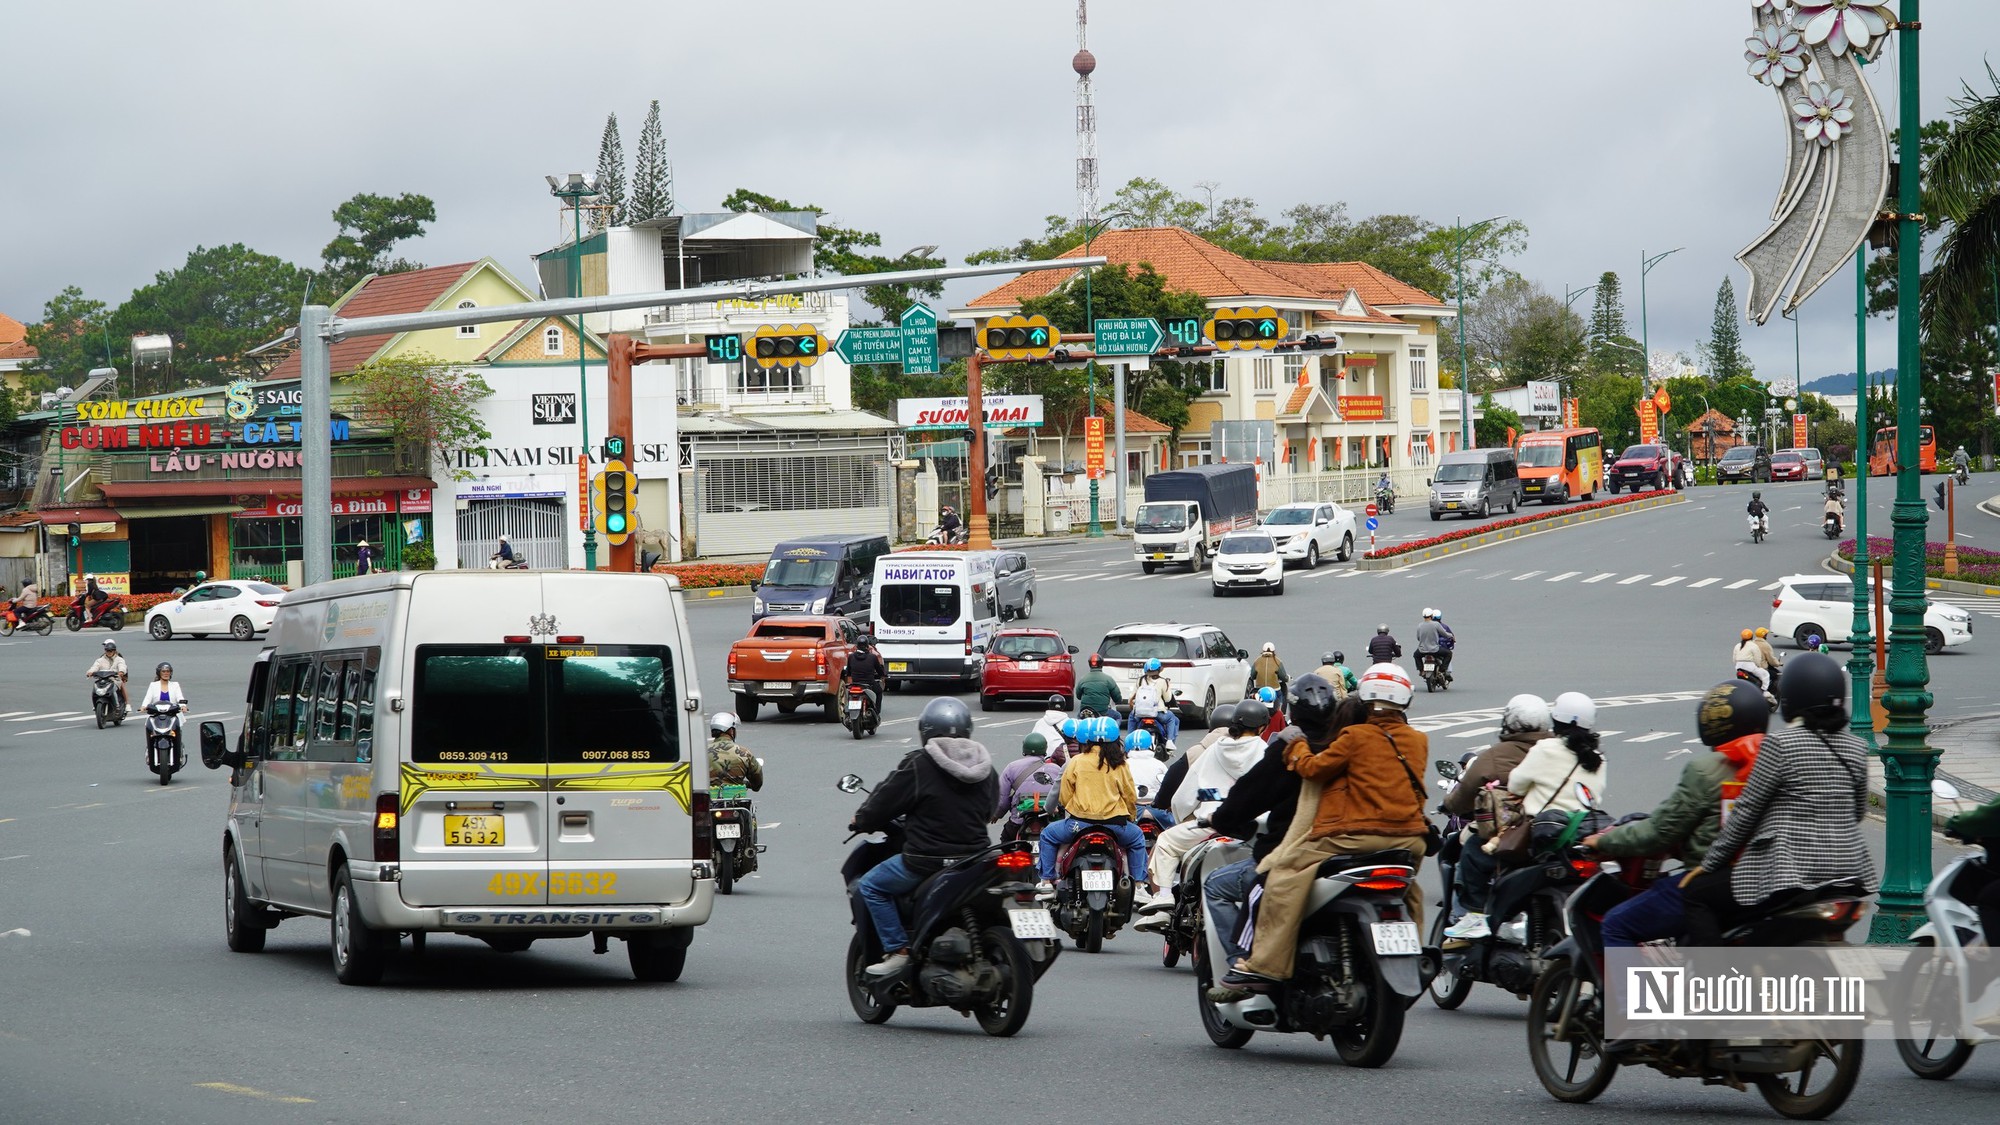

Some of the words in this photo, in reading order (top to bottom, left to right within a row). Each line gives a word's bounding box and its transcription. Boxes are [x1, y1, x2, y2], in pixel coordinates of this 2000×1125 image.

[1098, 322, 1113, 330] KHU
[1130, 319, 1148, 329] BÌNH
[850, 330, 862, 339] THÁC
[1102, 331, 1118, 341] CHỢ
[1119, 329, 1130, 340] ĐÀ
[1131, 331, 1146, 342] LẠT
[1169, 320, 1198, 344] 40
[886, 340, 900, 350] LÂM
[911, 336, 928, 345] THÁC
[709, 336, 739, 360] 40
[908, 347, 923, 355] CAM
[924, 347, 931, 355] LY
[1098, 342, 1107, 352] HỒ
[1108, 342, 1125, 352] XUÂN
[864, 354, 870, 362] XE
[871, 352, 885, 361] LIÊN
[908, 356, 920, 364] NHÀ
[924, 364, 931, 373] GÀ
[267, 390, 302, 404] SAIG
[535, 395, 575, 404] VIETNAM
[76, 399, 128, 420] SƠN
[134, 396, 205, 419] CƯỚC
[534, 403, 574, 419] SILK
[916, 408, 969, 425] SƯƠN
[990, 406, 1029, 421] MAI
[61, 424, 128, 450] CƠM
[139, 420, 211, 447] NIÊU
[243, 416, 280, 444] CÁ
[289, 420, 350, 443] TM
[607, 440, 622, 454] 40
[150, 447, 200, 472] LẨU
[221, 449, 303, 469] NƯỚN
[442, 447, 541, 468] VIETNAM
[548, 445, 600, 466] SILK
[349, 499, 387, 513] Đình
[885, 569, 955, 580] НАВИГАТОР
[439, 752, 488, 761] 0859.309
[489, 752, 508, 761] 413
[582, 751, 630, 760] 0907.068
[631, 751, 650, 760] 853
[461, 817, 487, 830] 49X
[451, 831, 498, 844] 5632
[489, 913, 621, 925] TRANSIT
